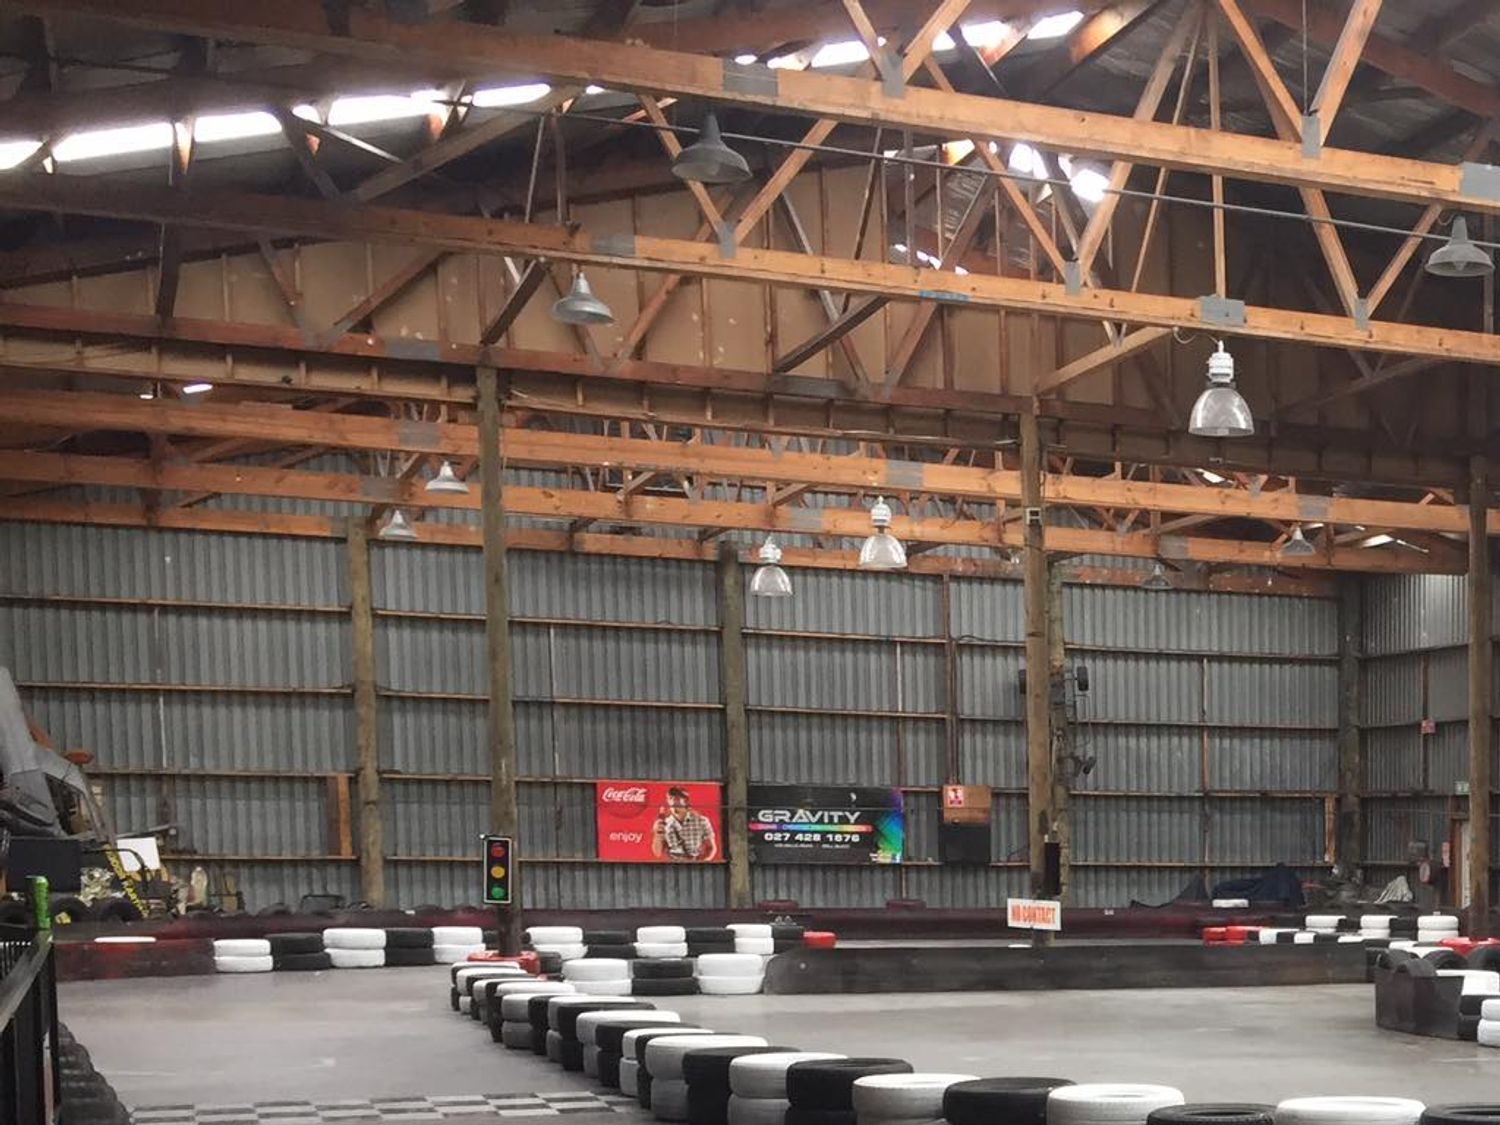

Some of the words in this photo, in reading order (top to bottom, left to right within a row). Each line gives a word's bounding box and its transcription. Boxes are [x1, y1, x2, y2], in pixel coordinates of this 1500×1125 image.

[757, 809, 861, 824] GRAVITY
[609, 832, 643, 843] enjoy
[764, 832, 789, 842] 027
